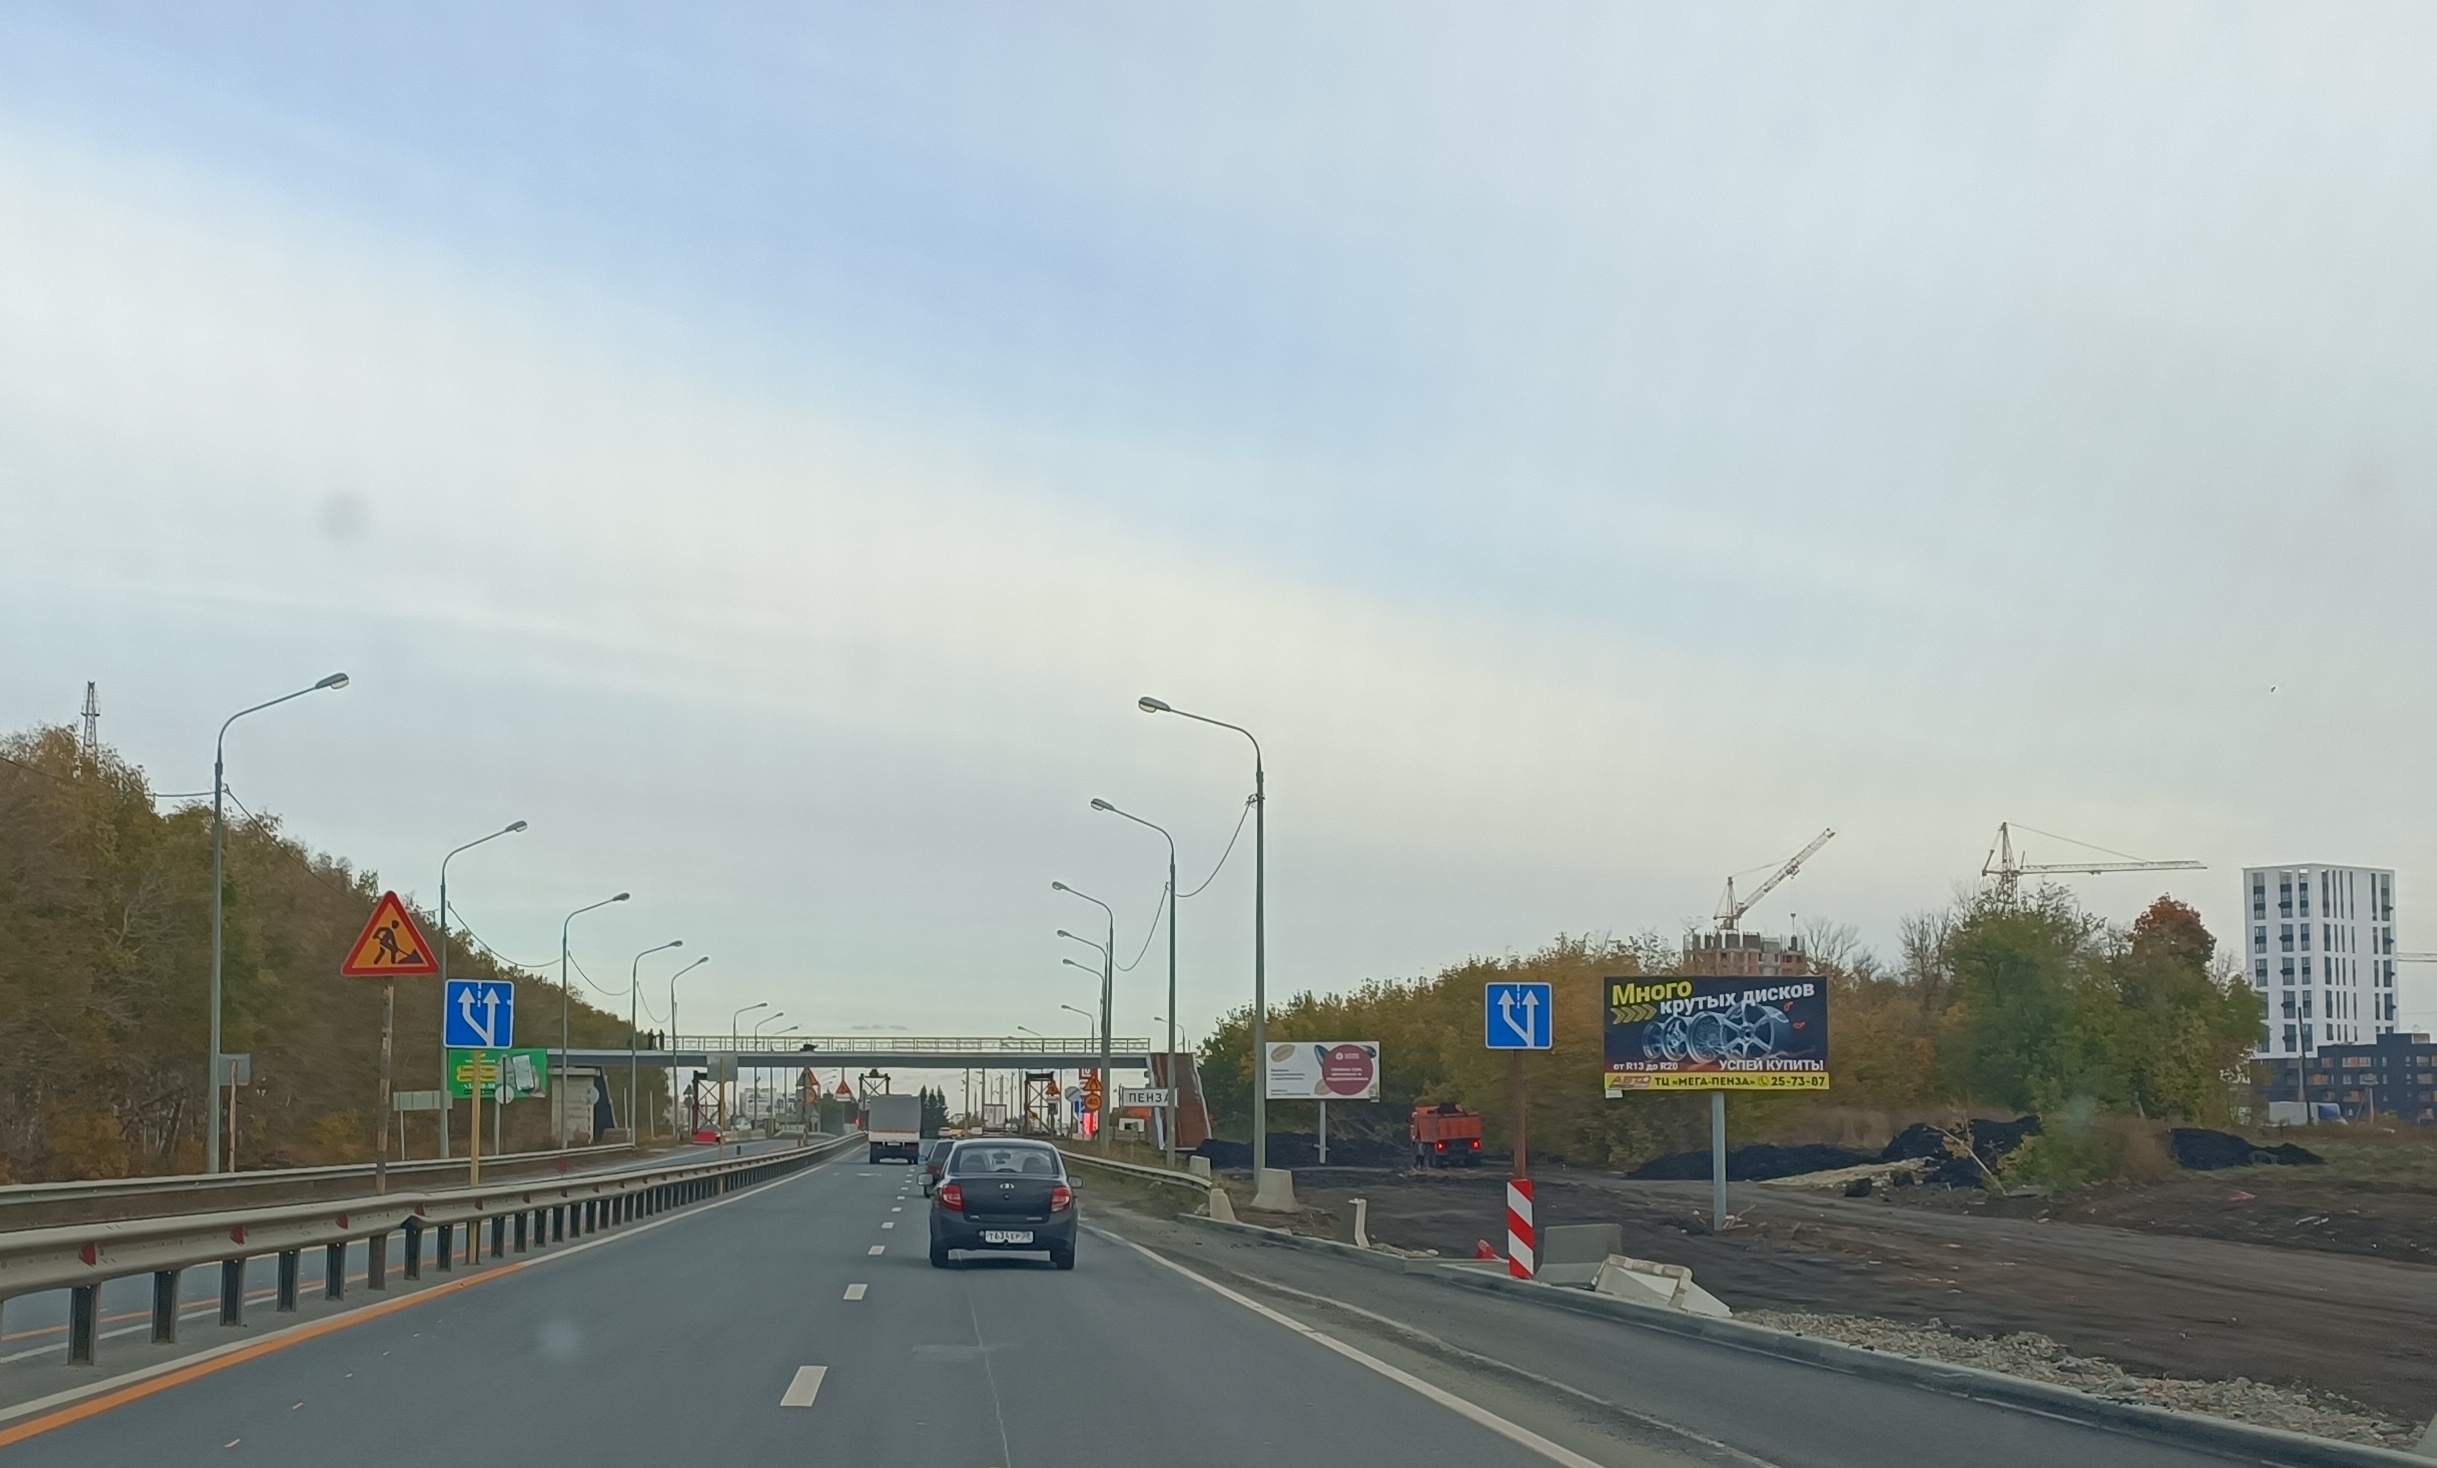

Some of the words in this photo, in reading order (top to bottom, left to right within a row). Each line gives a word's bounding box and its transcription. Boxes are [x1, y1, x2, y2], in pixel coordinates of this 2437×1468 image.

[1612, 981, 1692, 1005] Много
[1660, 992, 1736, 1017] крутых
[1742, 983, 1815, 1007] дисков
[1626, 1062, 1644, 1070] R13
[1646, 1063, 1658, 1071] до
[1660, 1062, 1678, 1070] R20
[1719, 1058, 1763, 1071] УСПЕЙ
[1766, 1060, 1824, 1071] КУПИТЬ!
[1655, 1077, 1669, 1087] ТЦ
